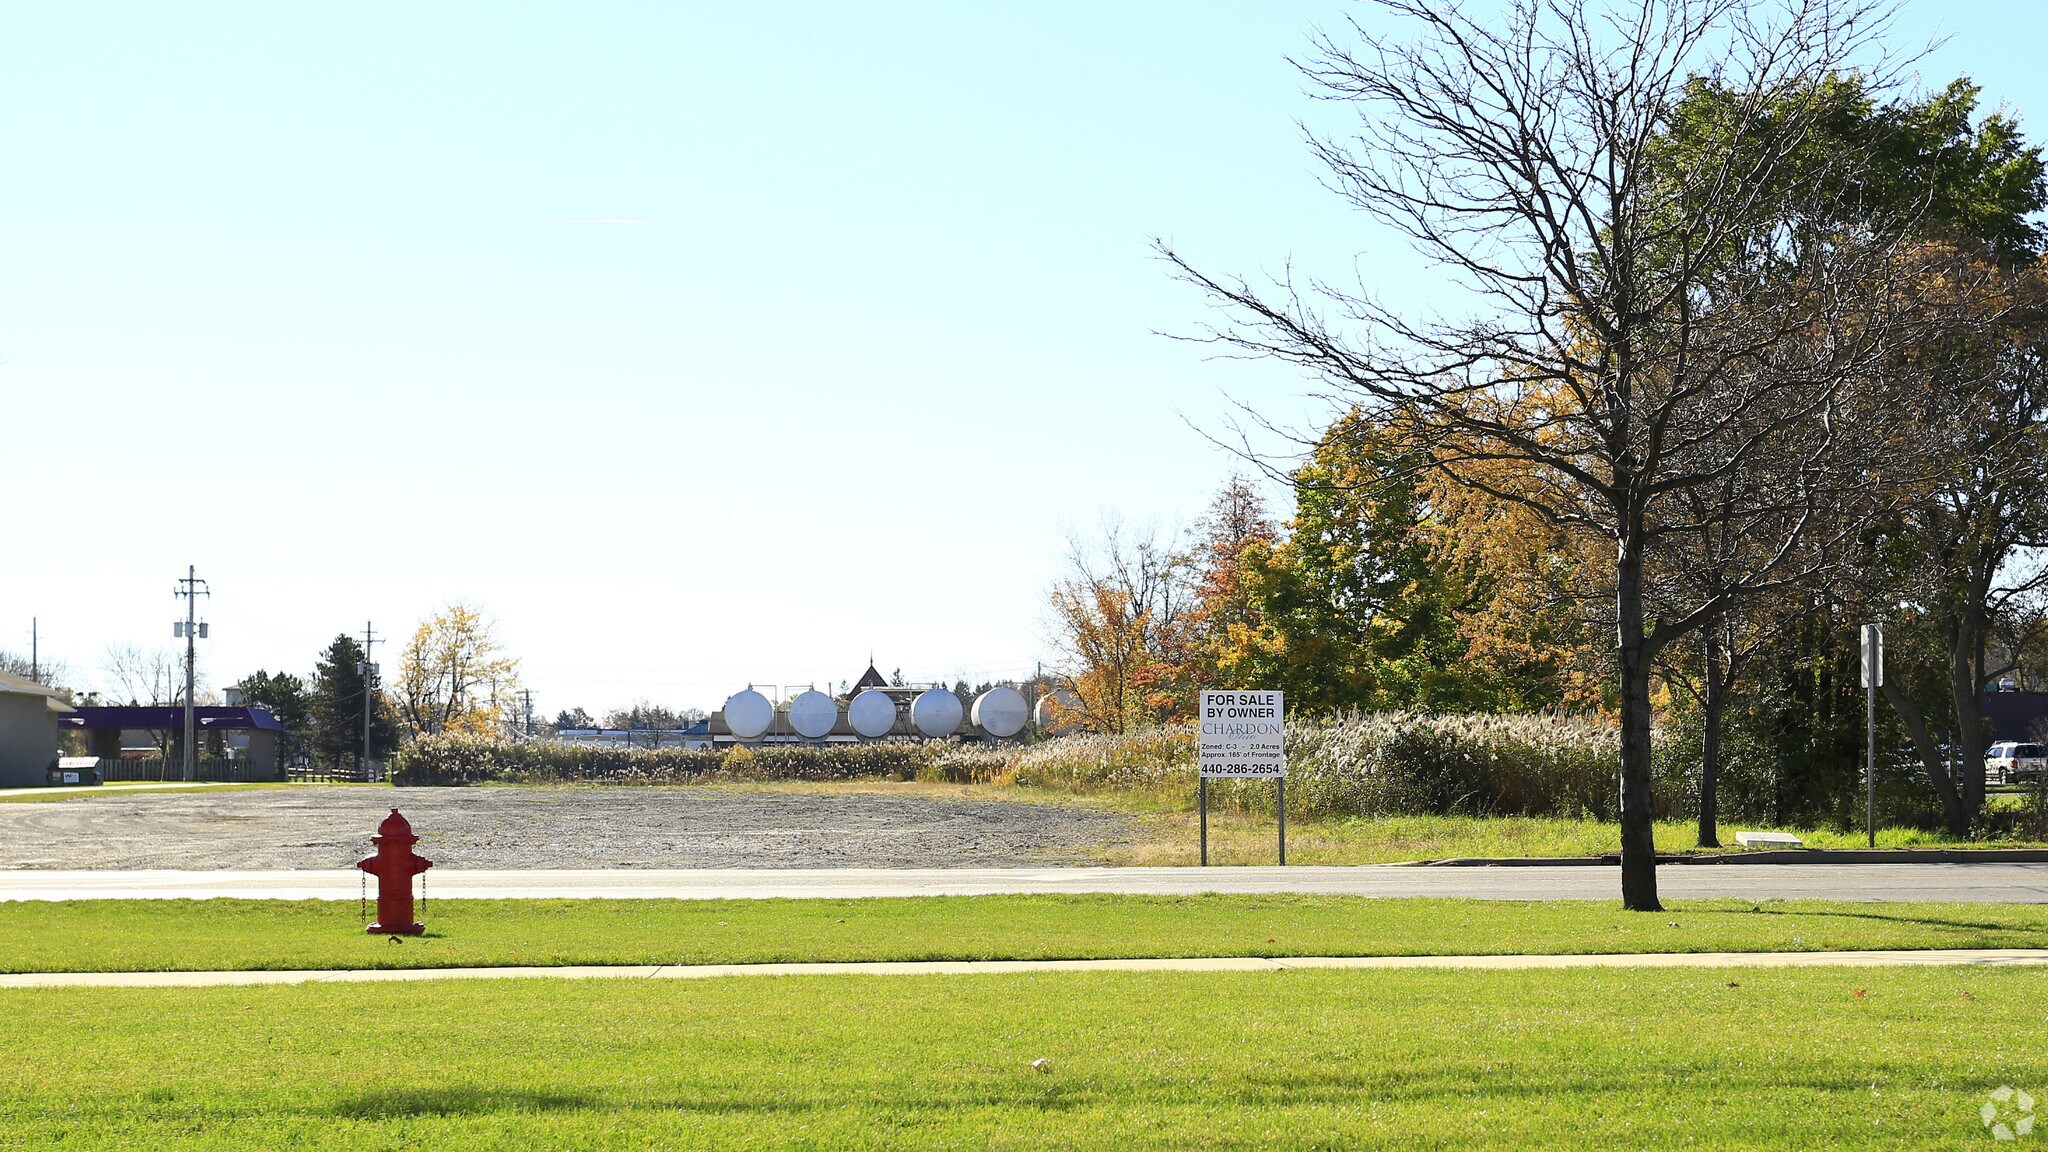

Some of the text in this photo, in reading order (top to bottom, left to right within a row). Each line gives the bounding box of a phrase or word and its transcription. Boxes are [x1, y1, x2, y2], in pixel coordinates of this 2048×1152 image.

[1207, 695, 1274, 706] FOR SALE
[1207, 708, 1275, 718] BY OWNER
[1202, 723, 1280, 735] CHARDON
[1201, 764, 1280, 774] 440-286-2654
